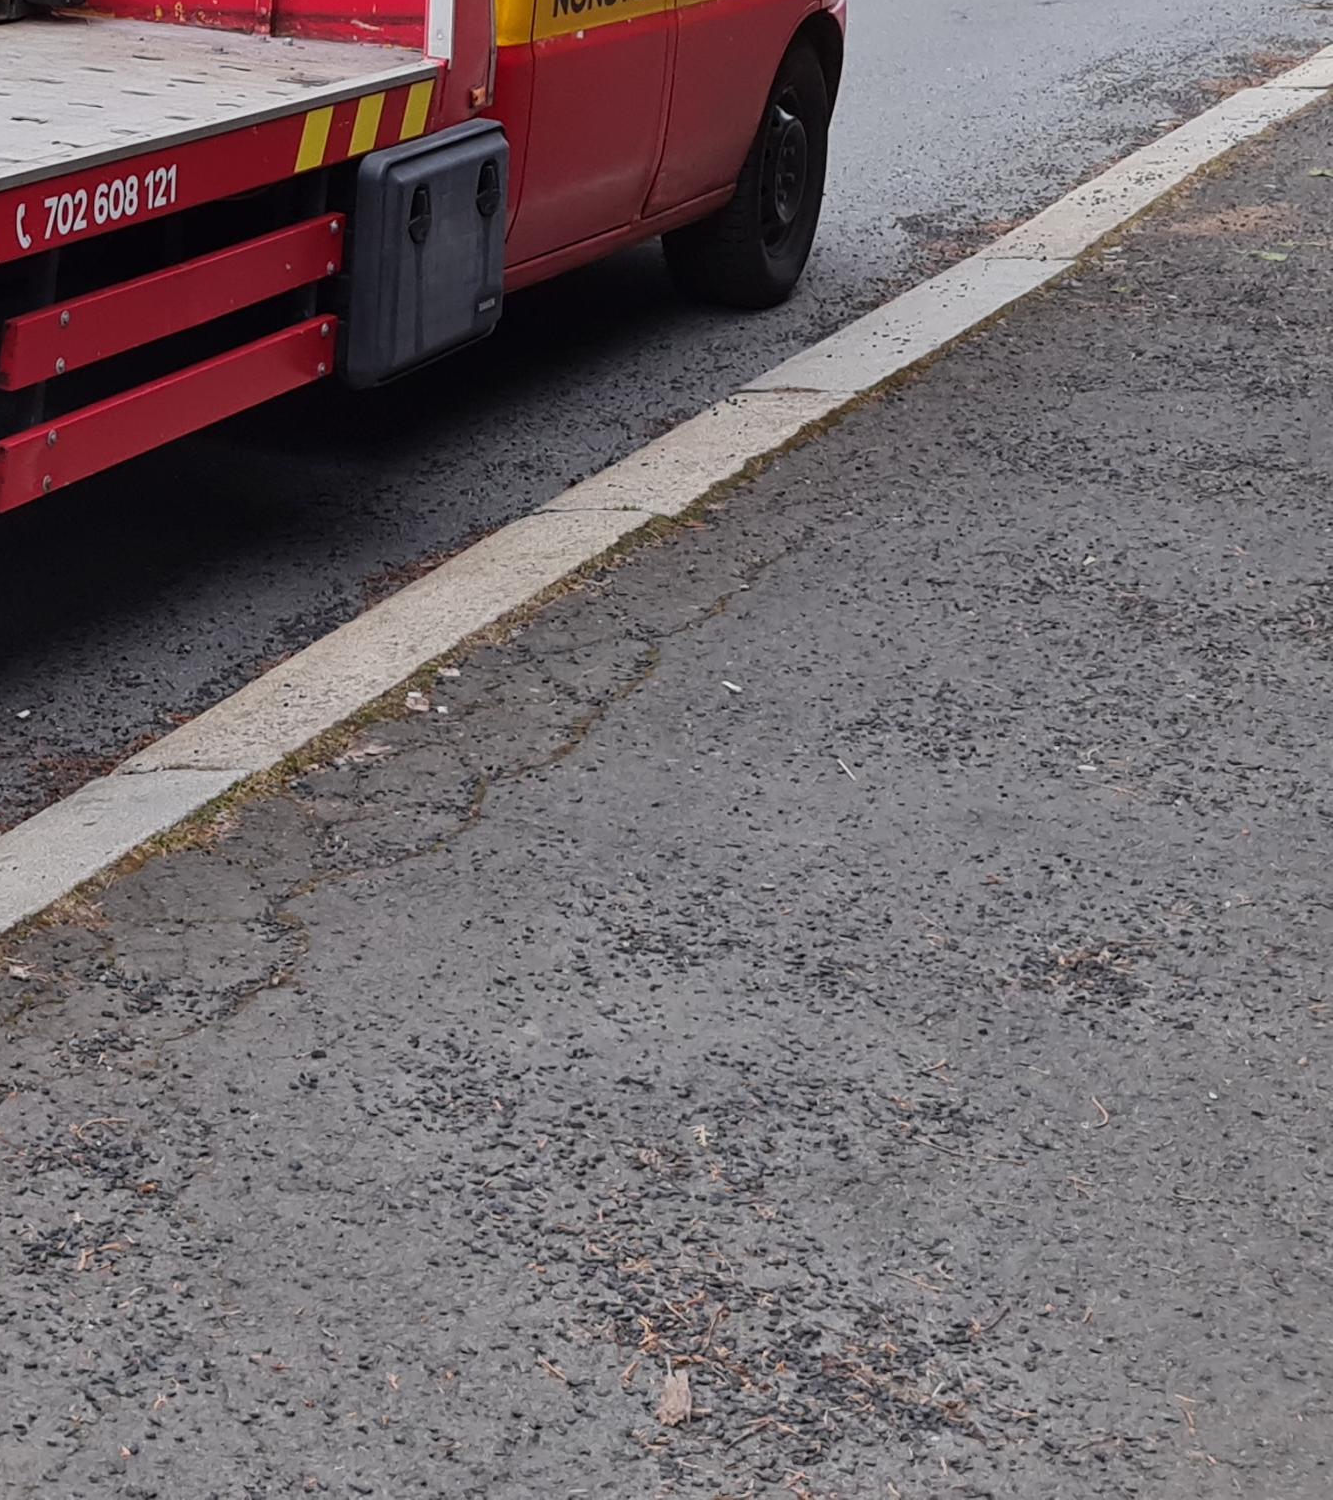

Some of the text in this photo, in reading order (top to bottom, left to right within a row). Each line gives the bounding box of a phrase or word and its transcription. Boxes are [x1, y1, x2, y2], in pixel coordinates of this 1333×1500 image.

[44, 164, 177, 239] 702 608 121
